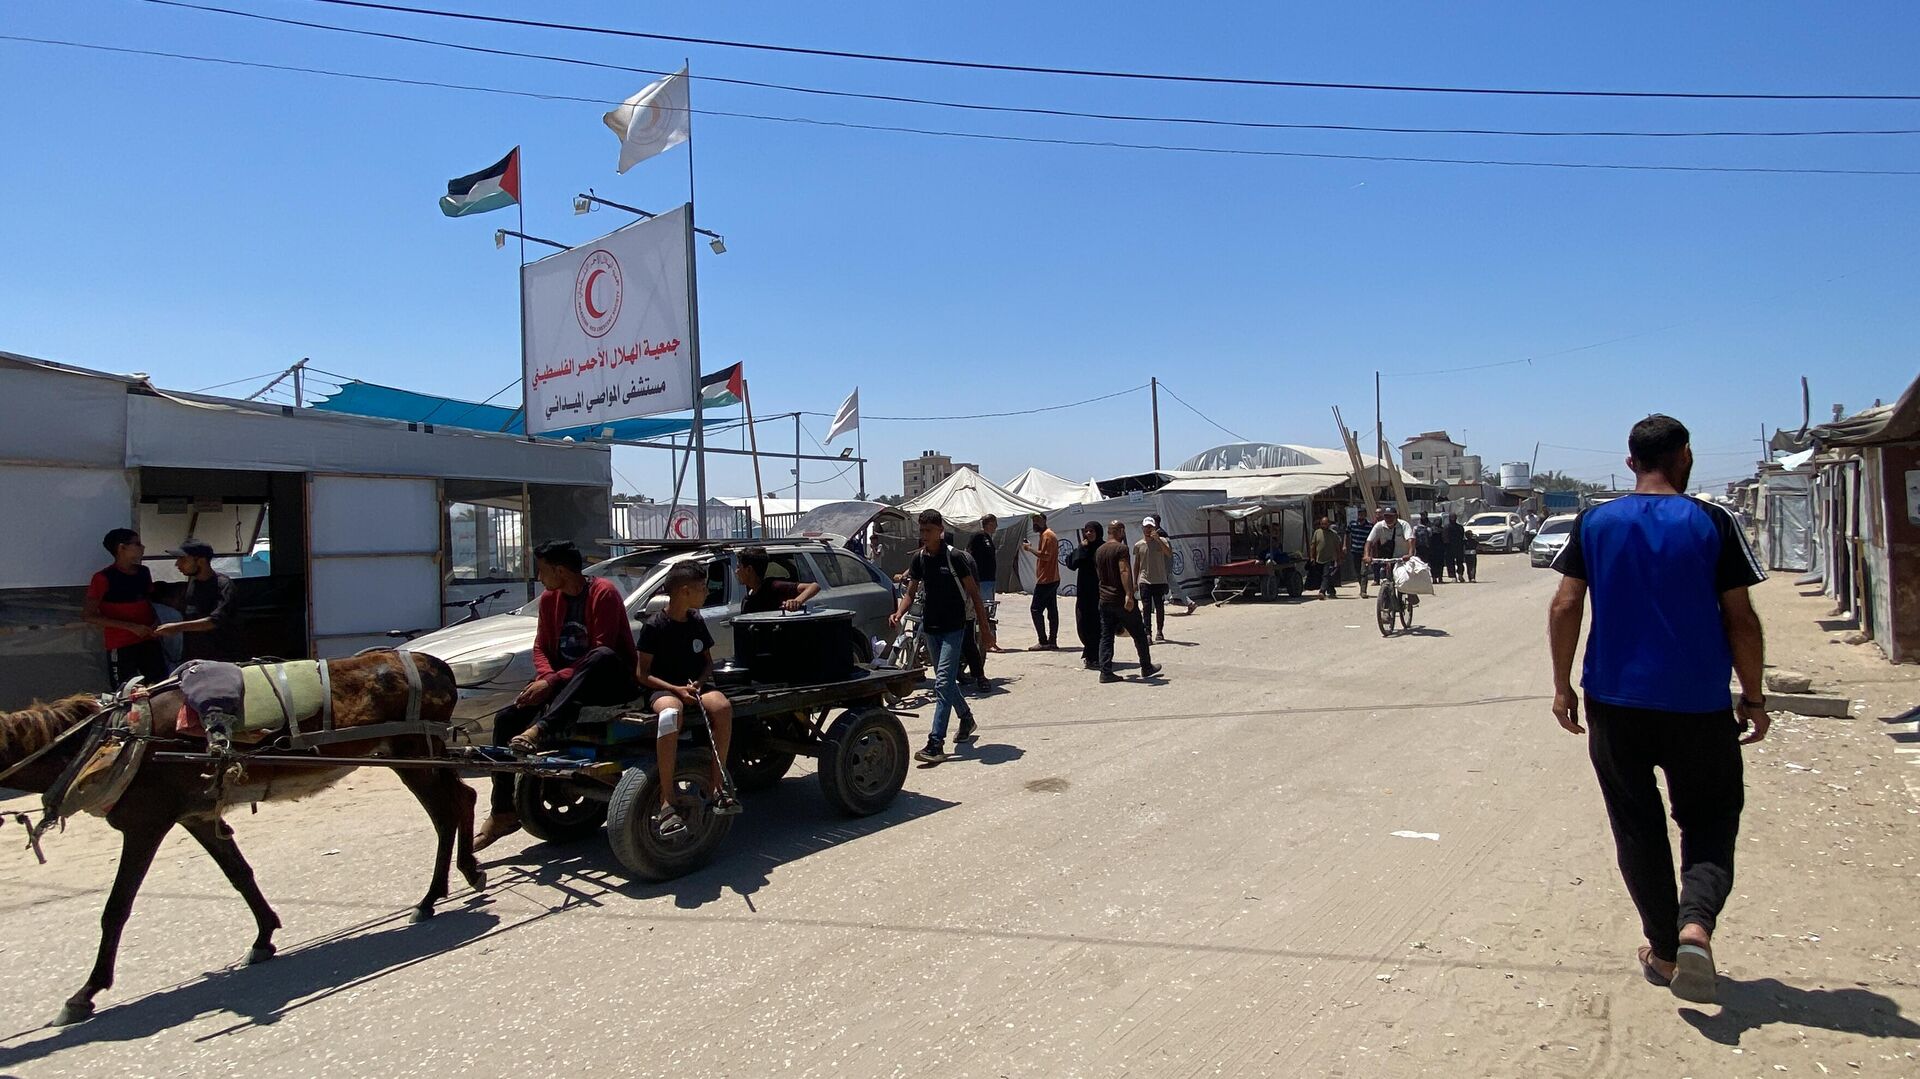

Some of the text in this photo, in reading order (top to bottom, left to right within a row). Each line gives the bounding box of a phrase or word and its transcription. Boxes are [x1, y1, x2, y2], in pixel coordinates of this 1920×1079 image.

[531, 336, 681, 391] جمعية الهلال الأحمر الفلسطيني
[545, 376, 666, 421] مستشفى المواصي الميداني
